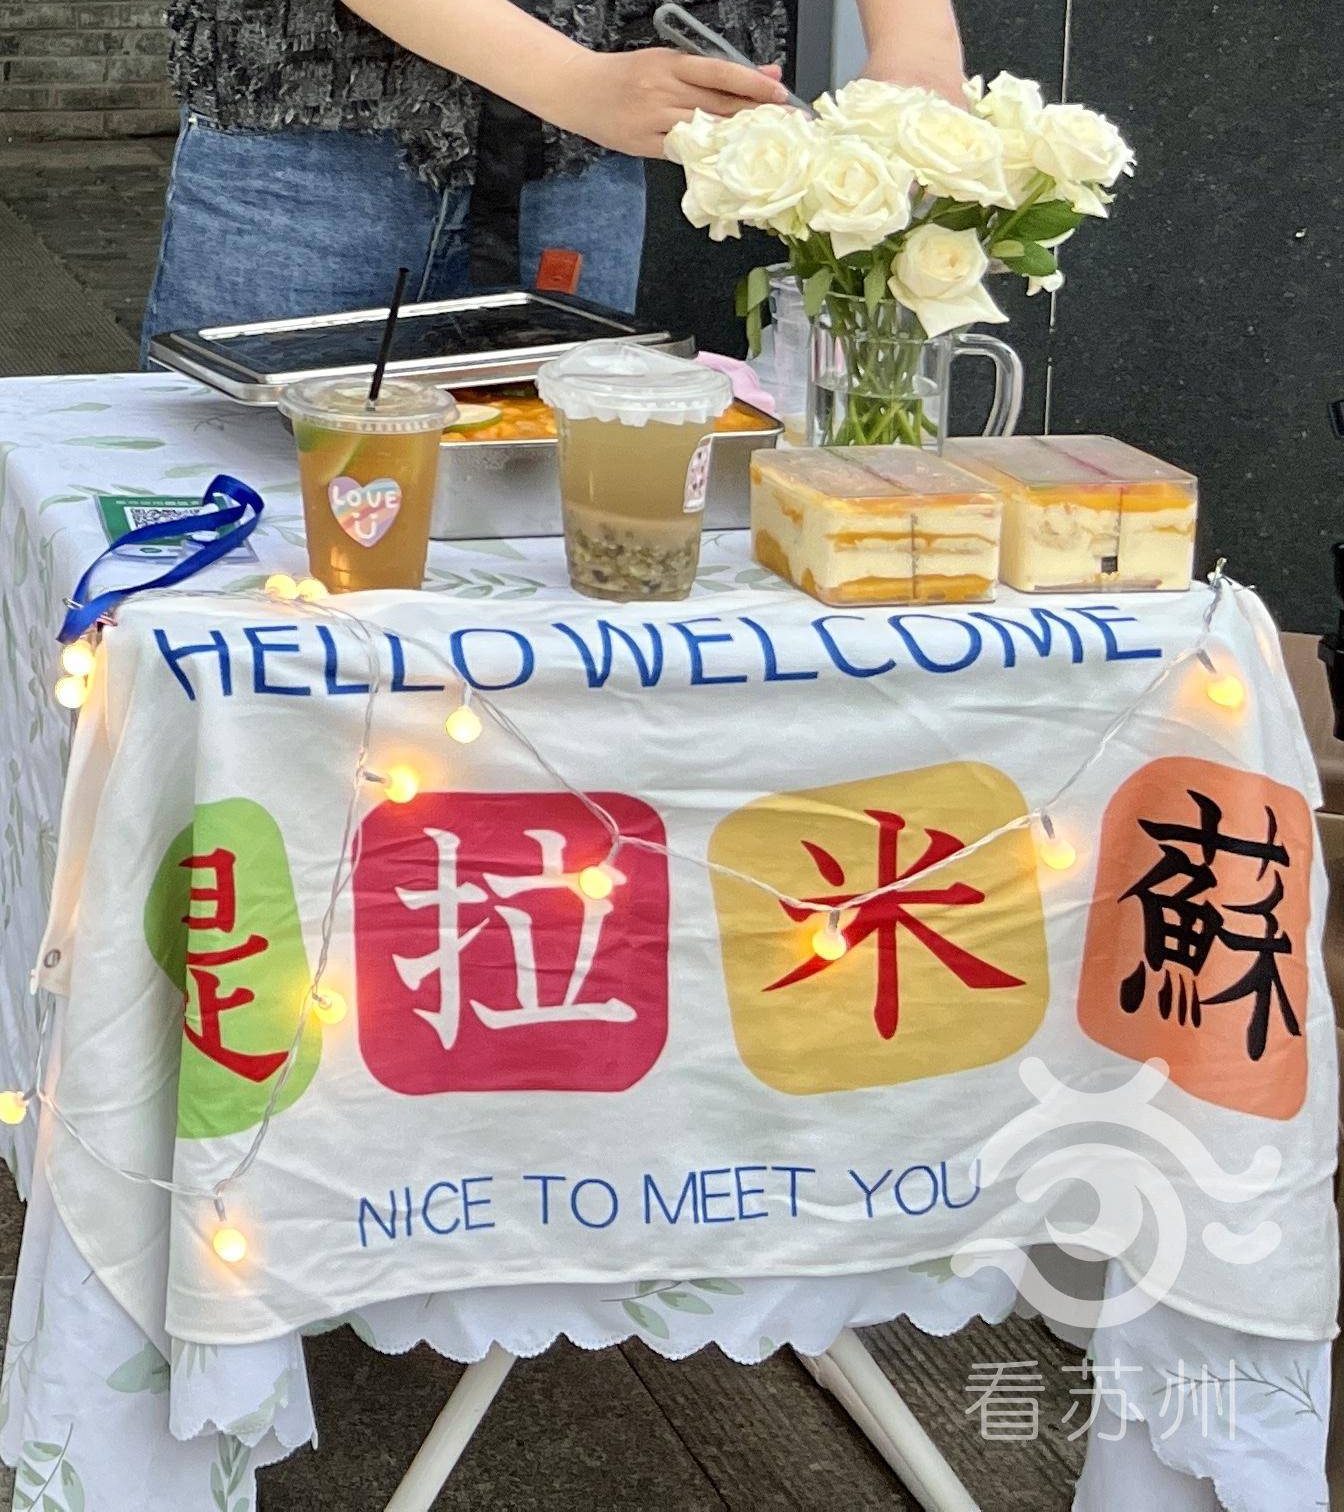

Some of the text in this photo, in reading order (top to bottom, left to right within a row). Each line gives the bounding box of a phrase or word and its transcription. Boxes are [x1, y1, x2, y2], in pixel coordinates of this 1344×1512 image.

[332, 485, 398, 509] LOVE
[152, 604, 1163, 703] HELLO WELCOME
[357, 1158, 983, 1247] NICE TO MEET YOU
